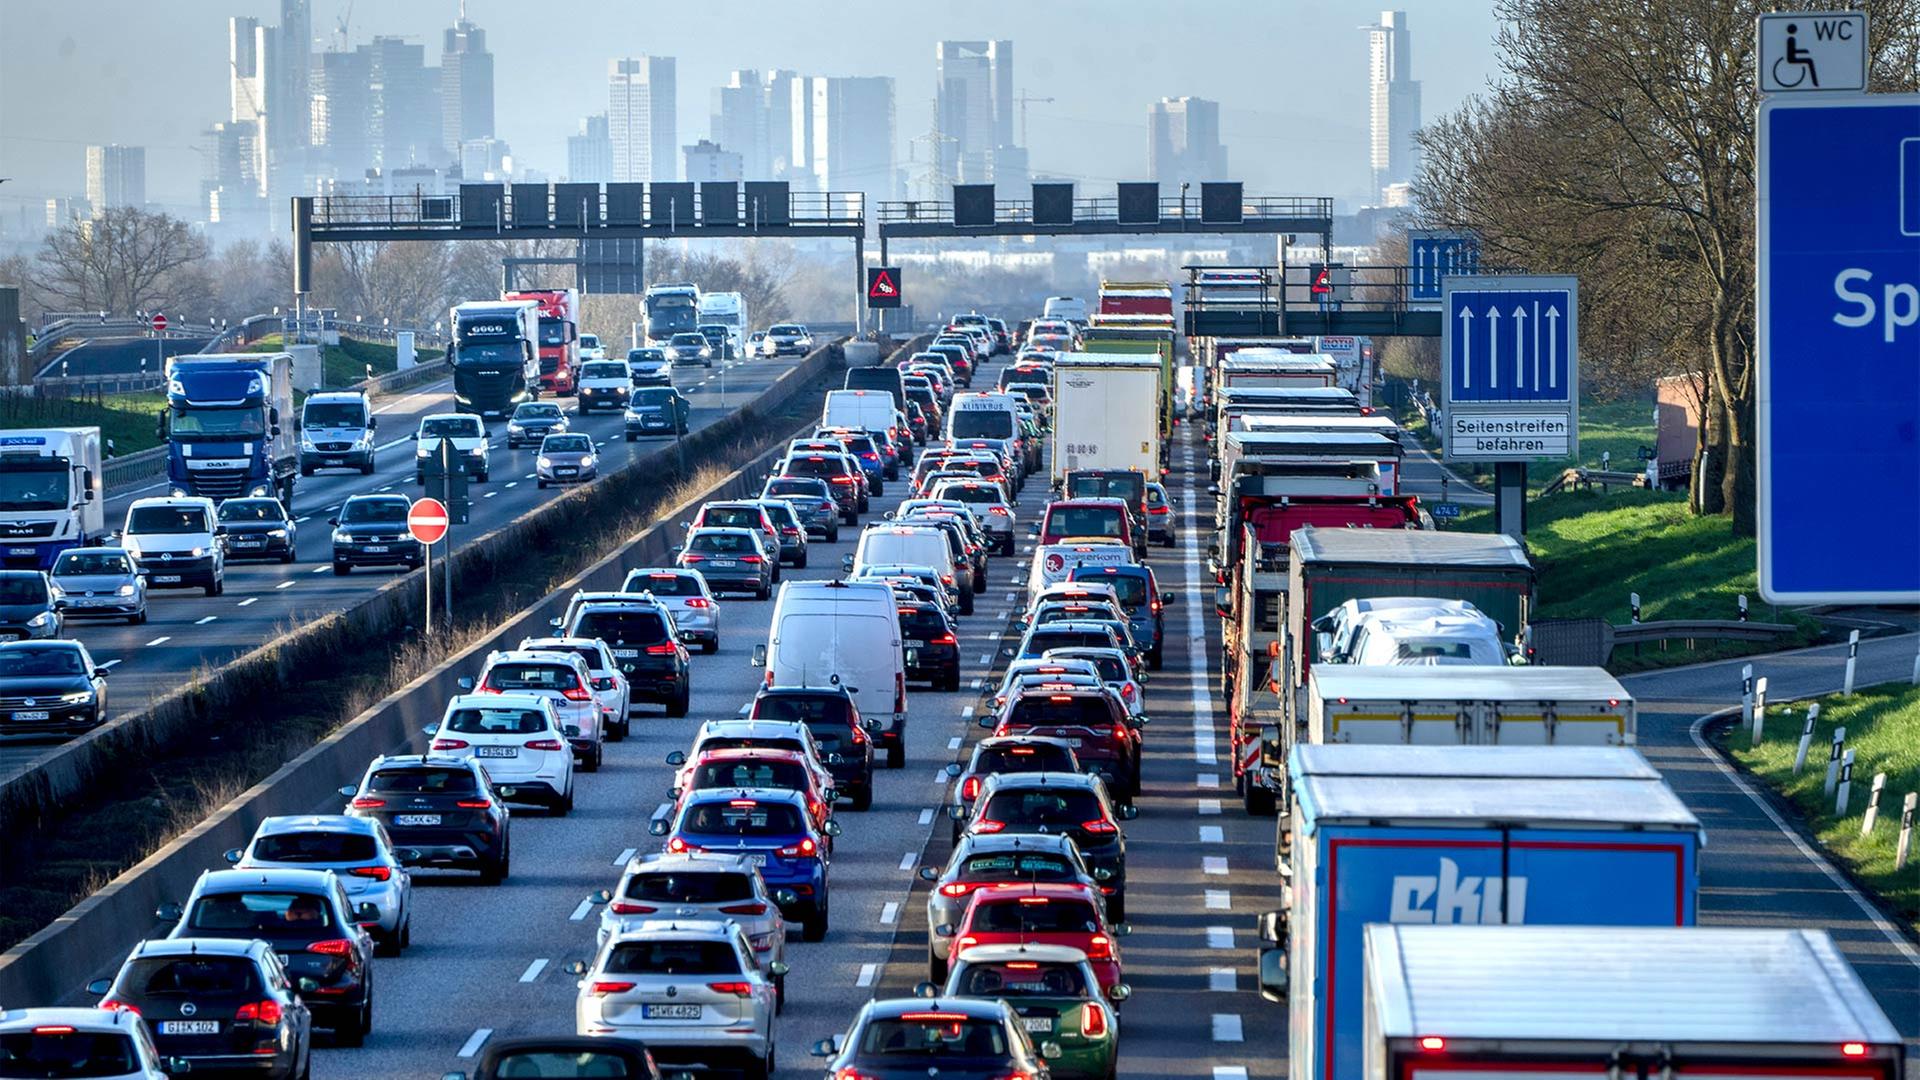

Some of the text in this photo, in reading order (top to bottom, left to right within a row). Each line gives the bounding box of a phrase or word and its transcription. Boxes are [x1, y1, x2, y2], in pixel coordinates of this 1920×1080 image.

[1814, 21, 1852, 40] WC
[1833, 268, 1920, 342] Sp
[1323, 339, 1352, 348] ROTH
[962, 402, 1003, 410] KLINIKBUS
[1457, 420, 1564, 433] Seitenstreifen
[1476, 438, 1544, 451] befahren
[675, 1007, 698, 1017] 4825
[196, 1023, 214, 1033] 102
